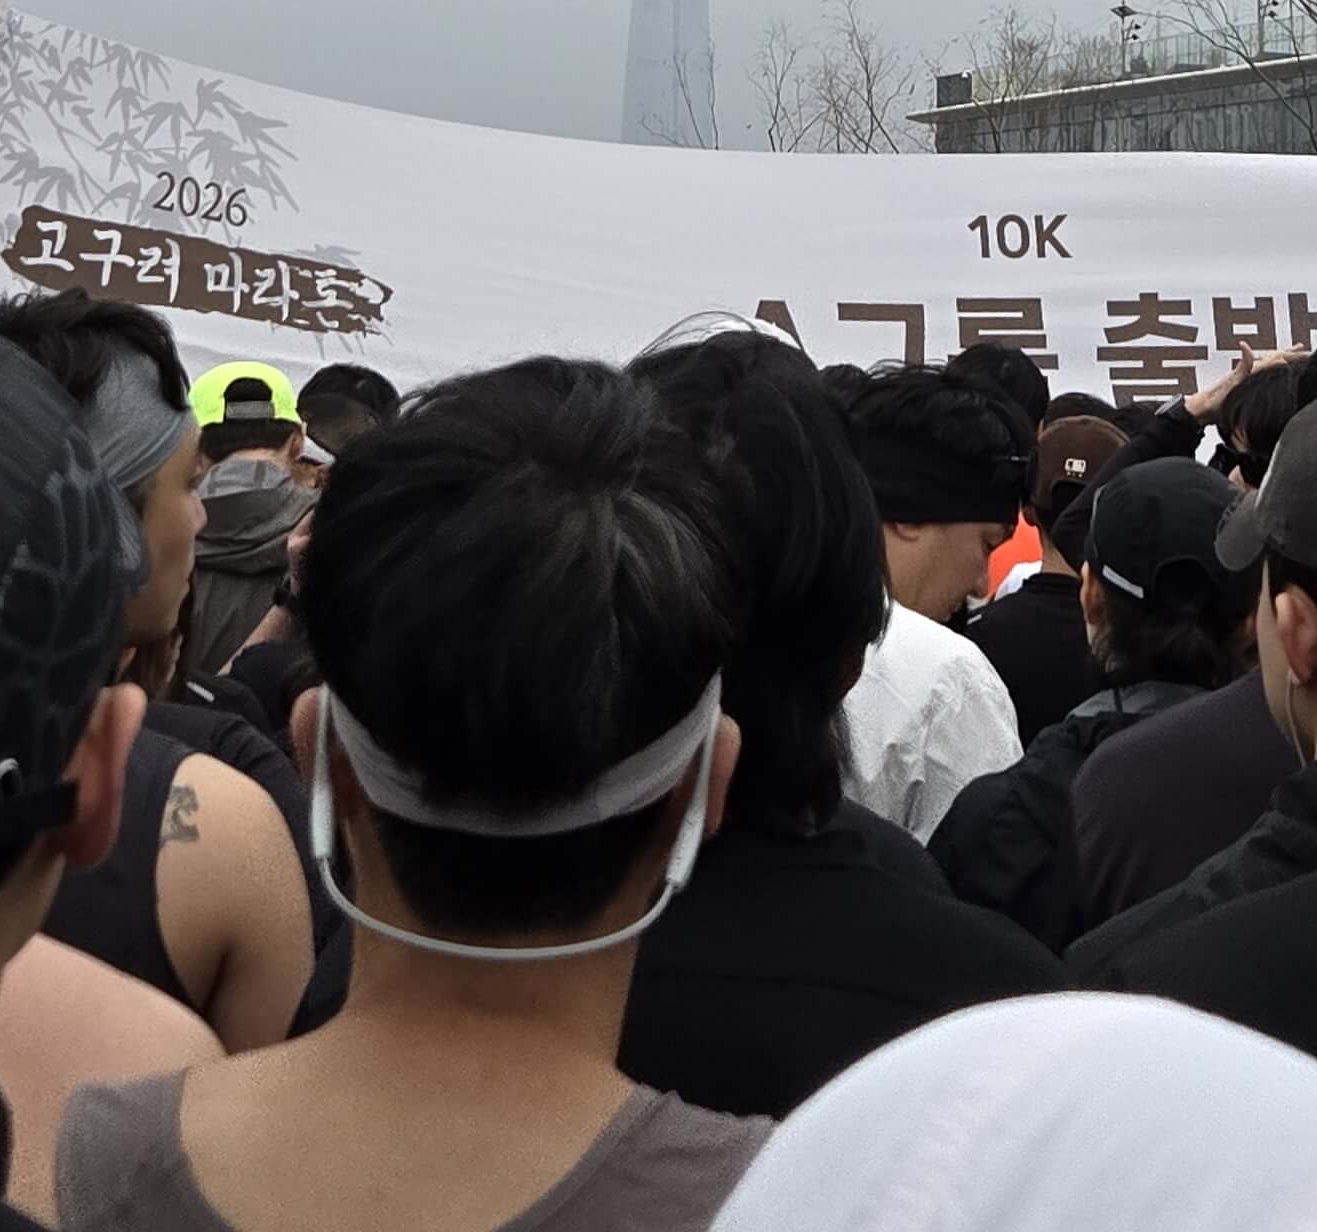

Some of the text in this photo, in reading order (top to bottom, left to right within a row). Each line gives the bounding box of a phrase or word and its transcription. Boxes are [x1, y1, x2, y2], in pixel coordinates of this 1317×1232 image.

[153, 171, 249, 227] 2026
[967, 213, 1073, 259] 10K
[20, 220, 383, 329] 고구려 마라톤
